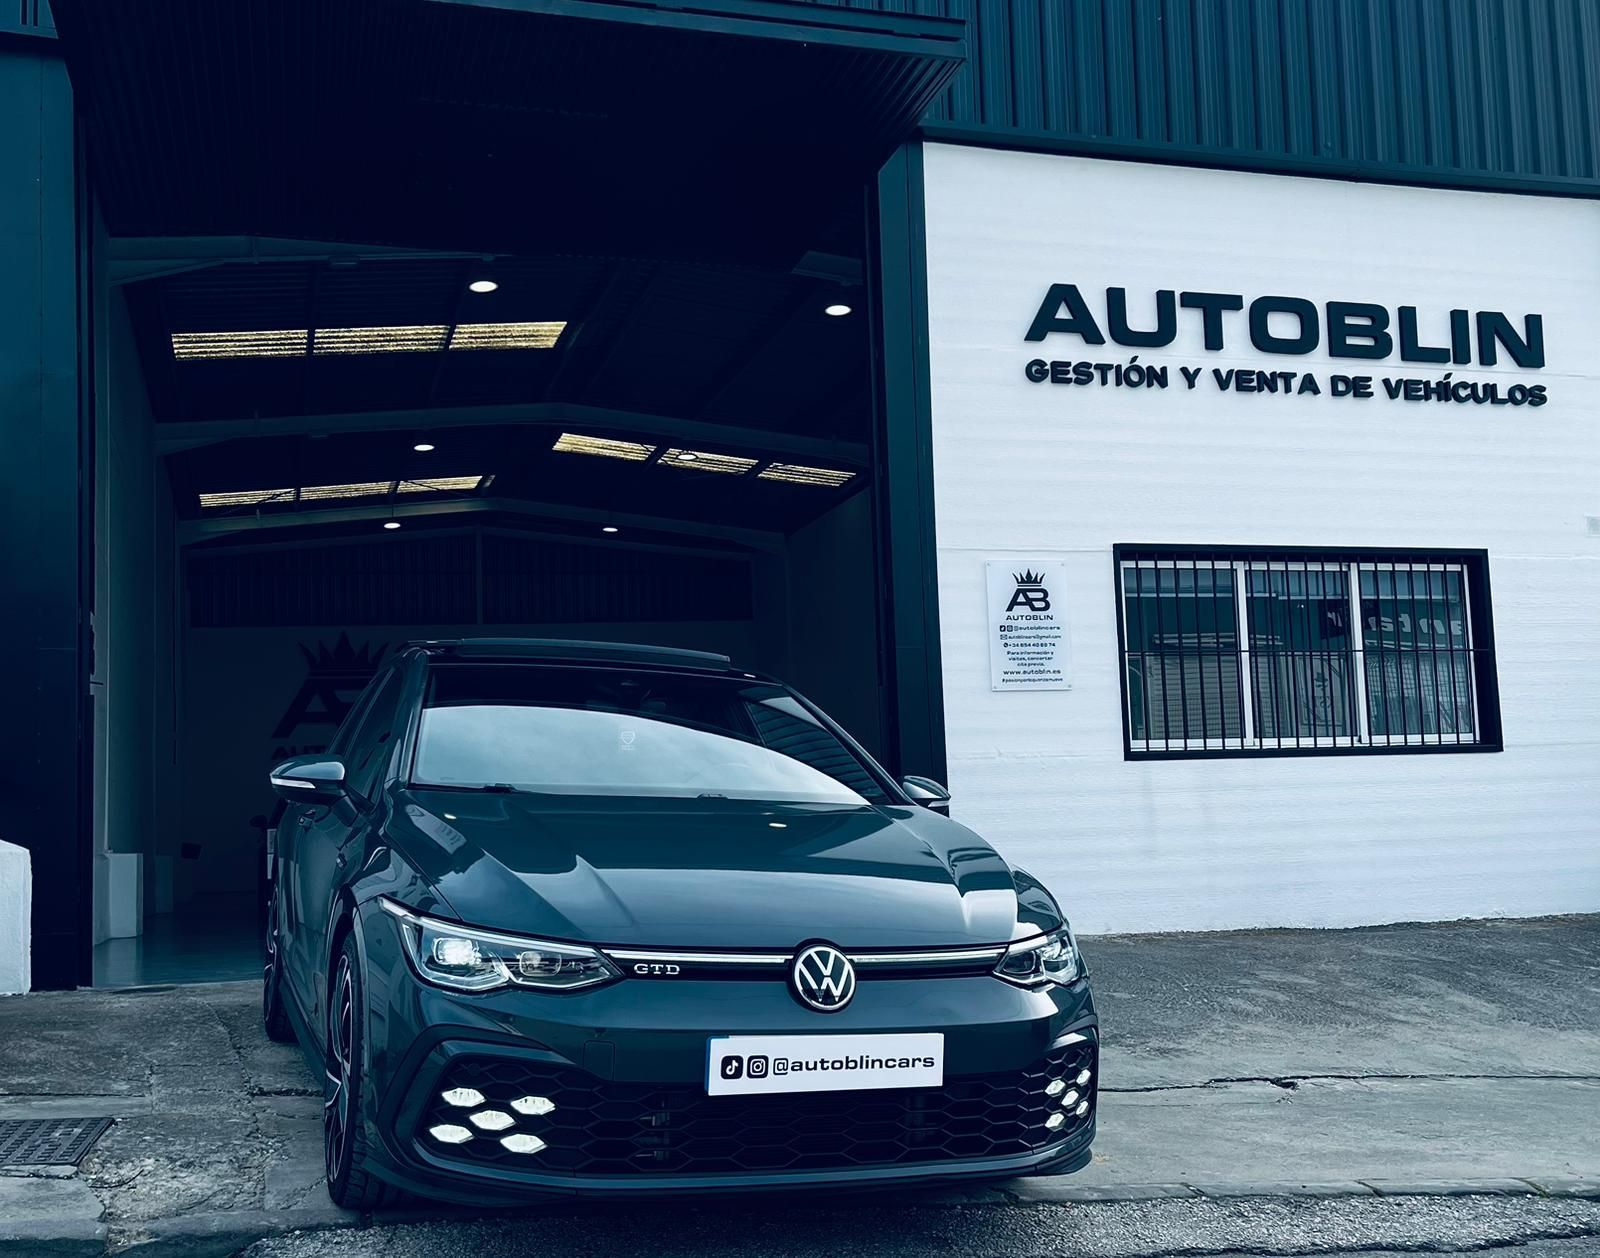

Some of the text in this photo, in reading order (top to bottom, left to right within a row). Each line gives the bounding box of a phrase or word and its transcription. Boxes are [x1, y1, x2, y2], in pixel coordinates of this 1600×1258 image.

[1024, 283, 1546, 369] AUTOBLIN
[1025, 355, 1548, 407] GESTIÓN Y VENTA DE VEHÍCULOS
[1005, 588, 1051, 612] AB
[633, 962, 681, 976] GTD
[773, 1054, 936, 1077] @autoblincars
